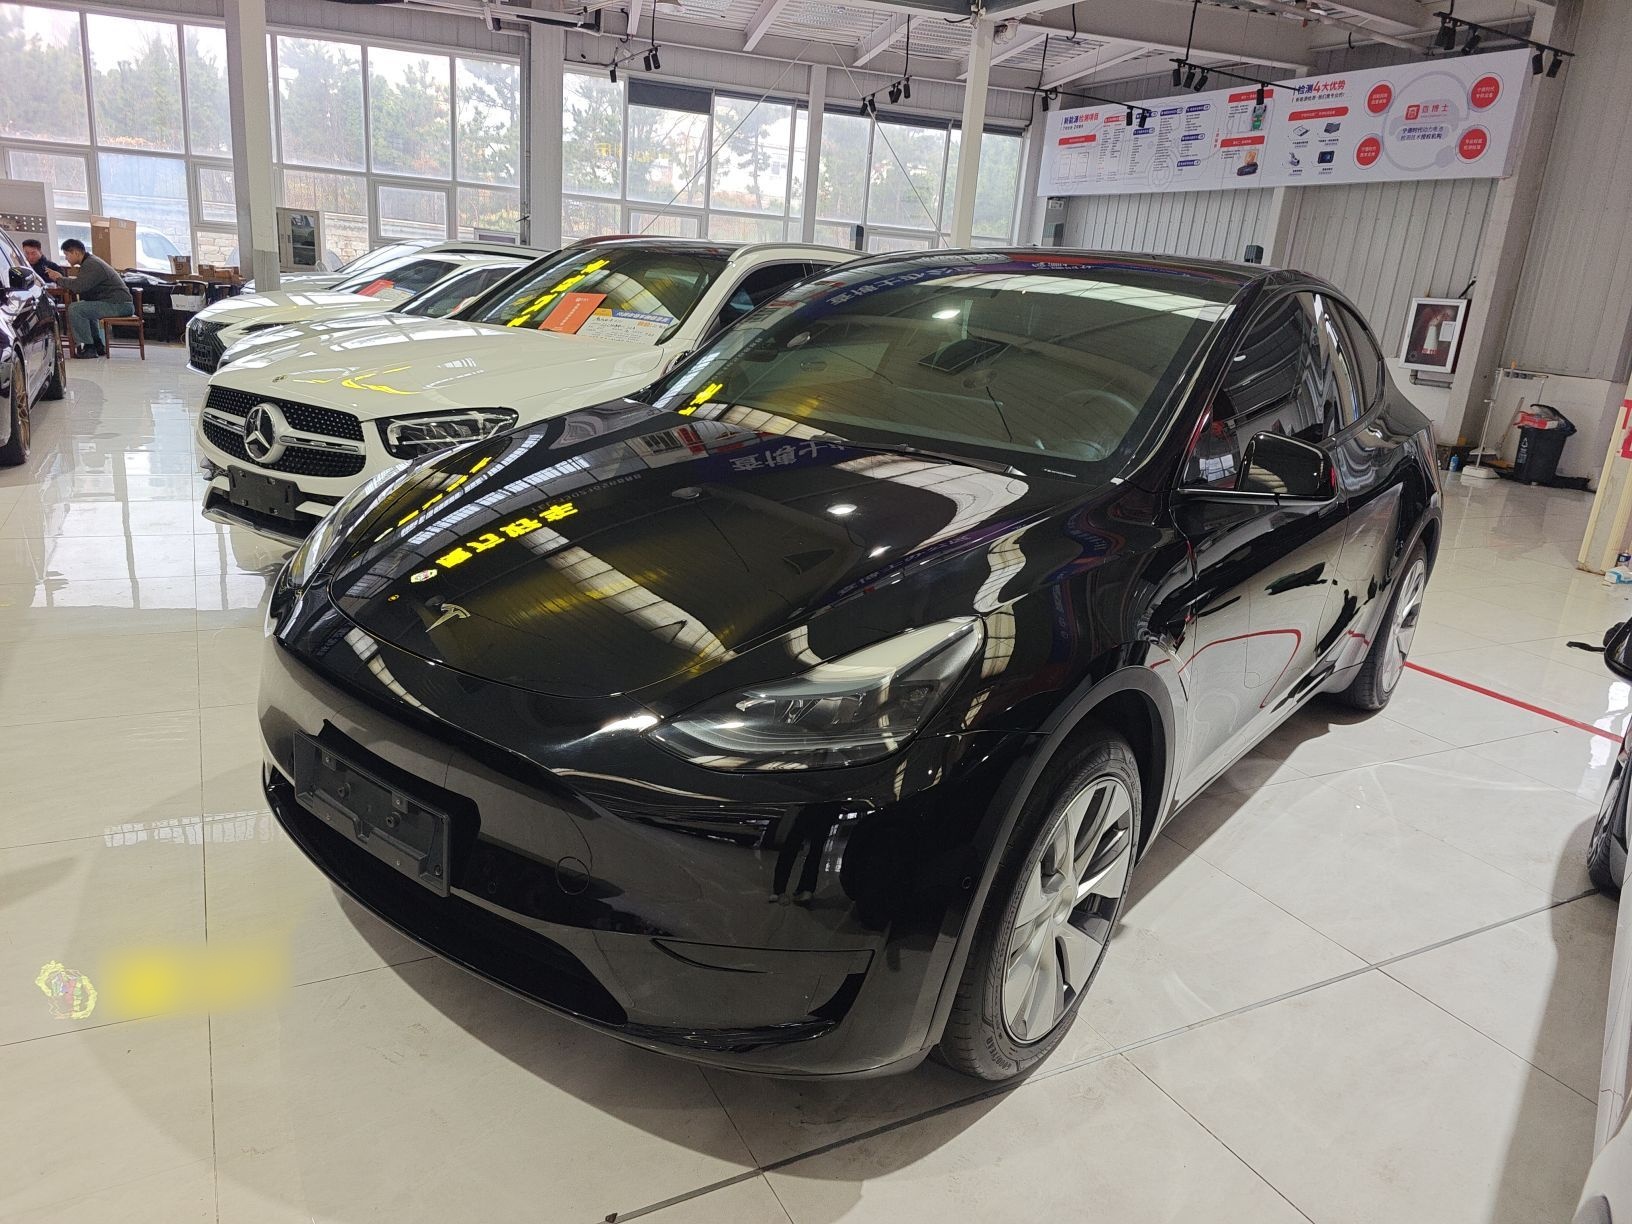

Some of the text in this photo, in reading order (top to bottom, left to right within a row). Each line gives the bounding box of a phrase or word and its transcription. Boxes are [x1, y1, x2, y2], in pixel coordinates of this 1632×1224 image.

[1297, 80, 1345, 95] 检测4大优势
